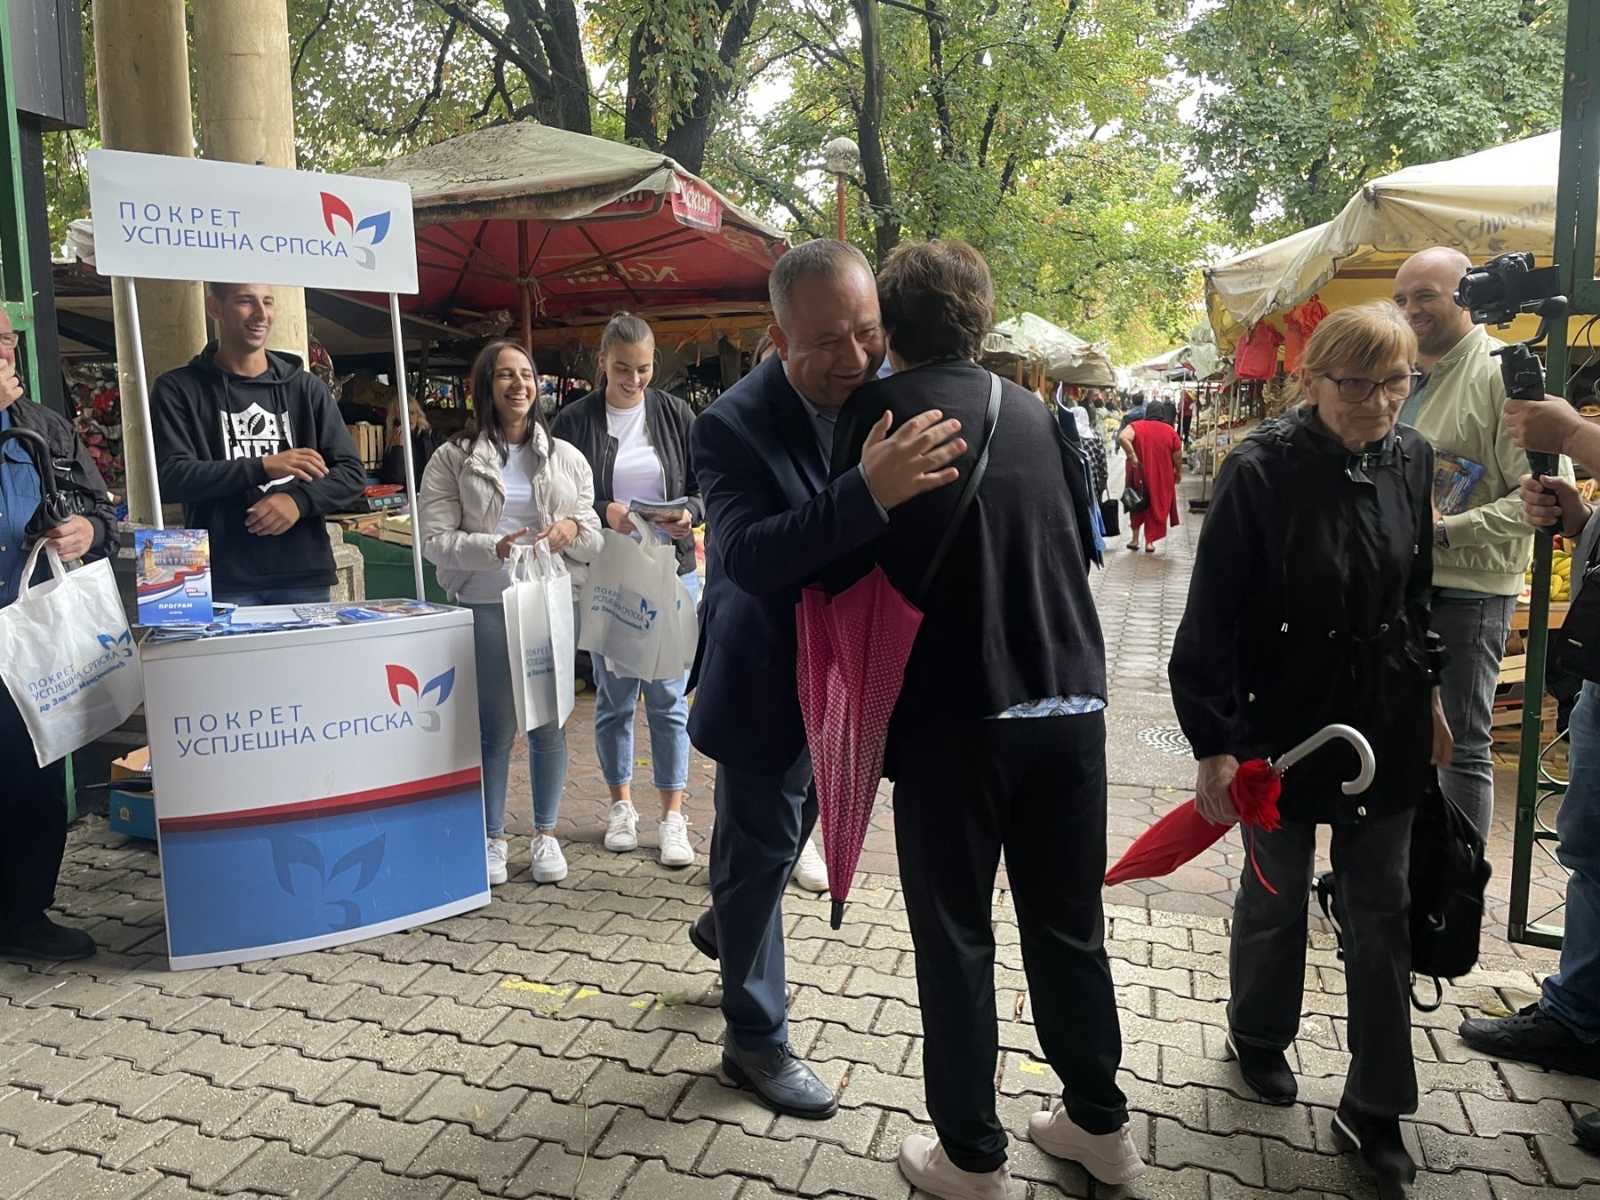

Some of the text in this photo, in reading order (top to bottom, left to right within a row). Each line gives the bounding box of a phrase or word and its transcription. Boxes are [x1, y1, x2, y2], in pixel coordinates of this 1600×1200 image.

[119, 201, 241, 228] ПОКРЕТ
[121, 225, 349, 258] УСПЈЕШНА СРПСКА
[28, 663, 75, 692] ПОКРЕТ
[174, 704, 303, 736] ПОКРЕТ
[177, 711, 414, 758] УСПЈЕШНА СРПСКА
